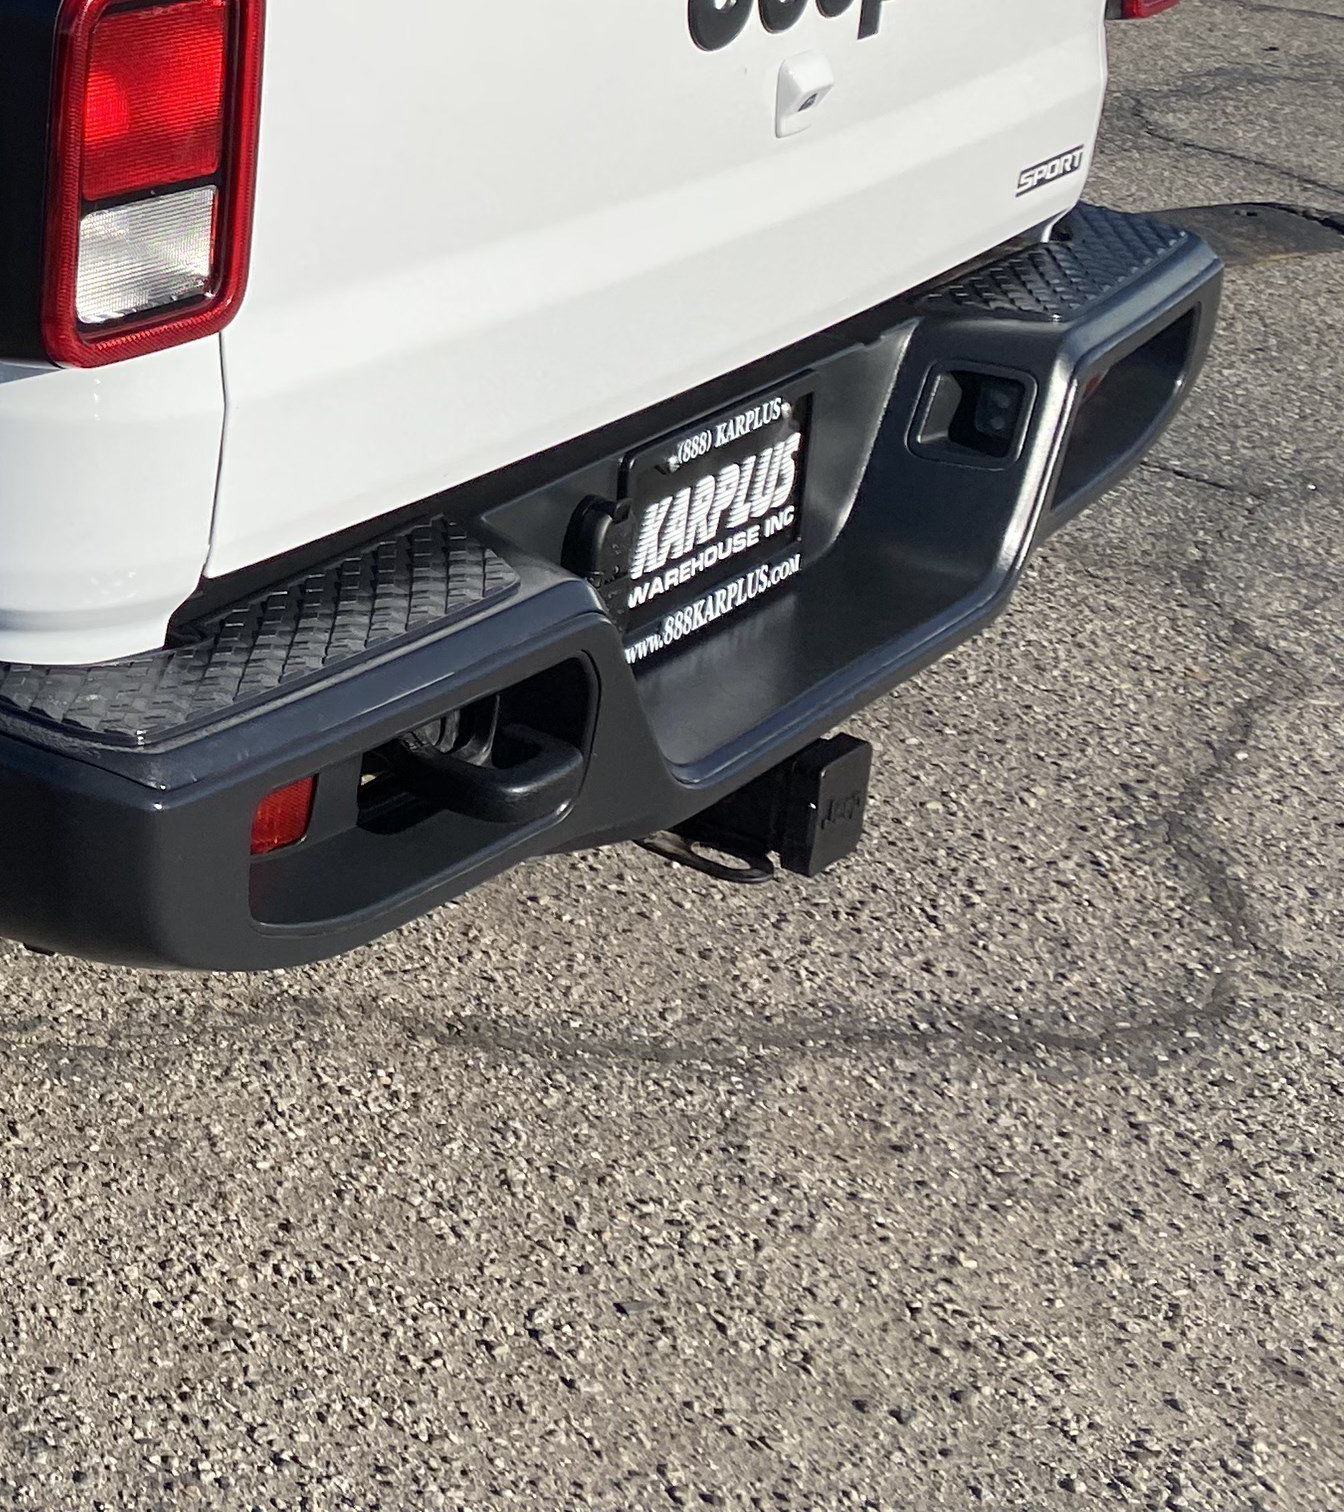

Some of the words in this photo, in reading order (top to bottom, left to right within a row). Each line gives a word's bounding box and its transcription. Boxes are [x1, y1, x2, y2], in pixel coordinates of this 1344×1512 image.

[1015, 145, 1085, 195] SPORT
[677, 432, 712, 465] (888)
[714, 397, 783, 449] KARPLUS
[629, 432, 801, 580] KARPLUS
[627, 524, 760, 609] WAREHOUSE
[764, 505, 795, 539] INC
